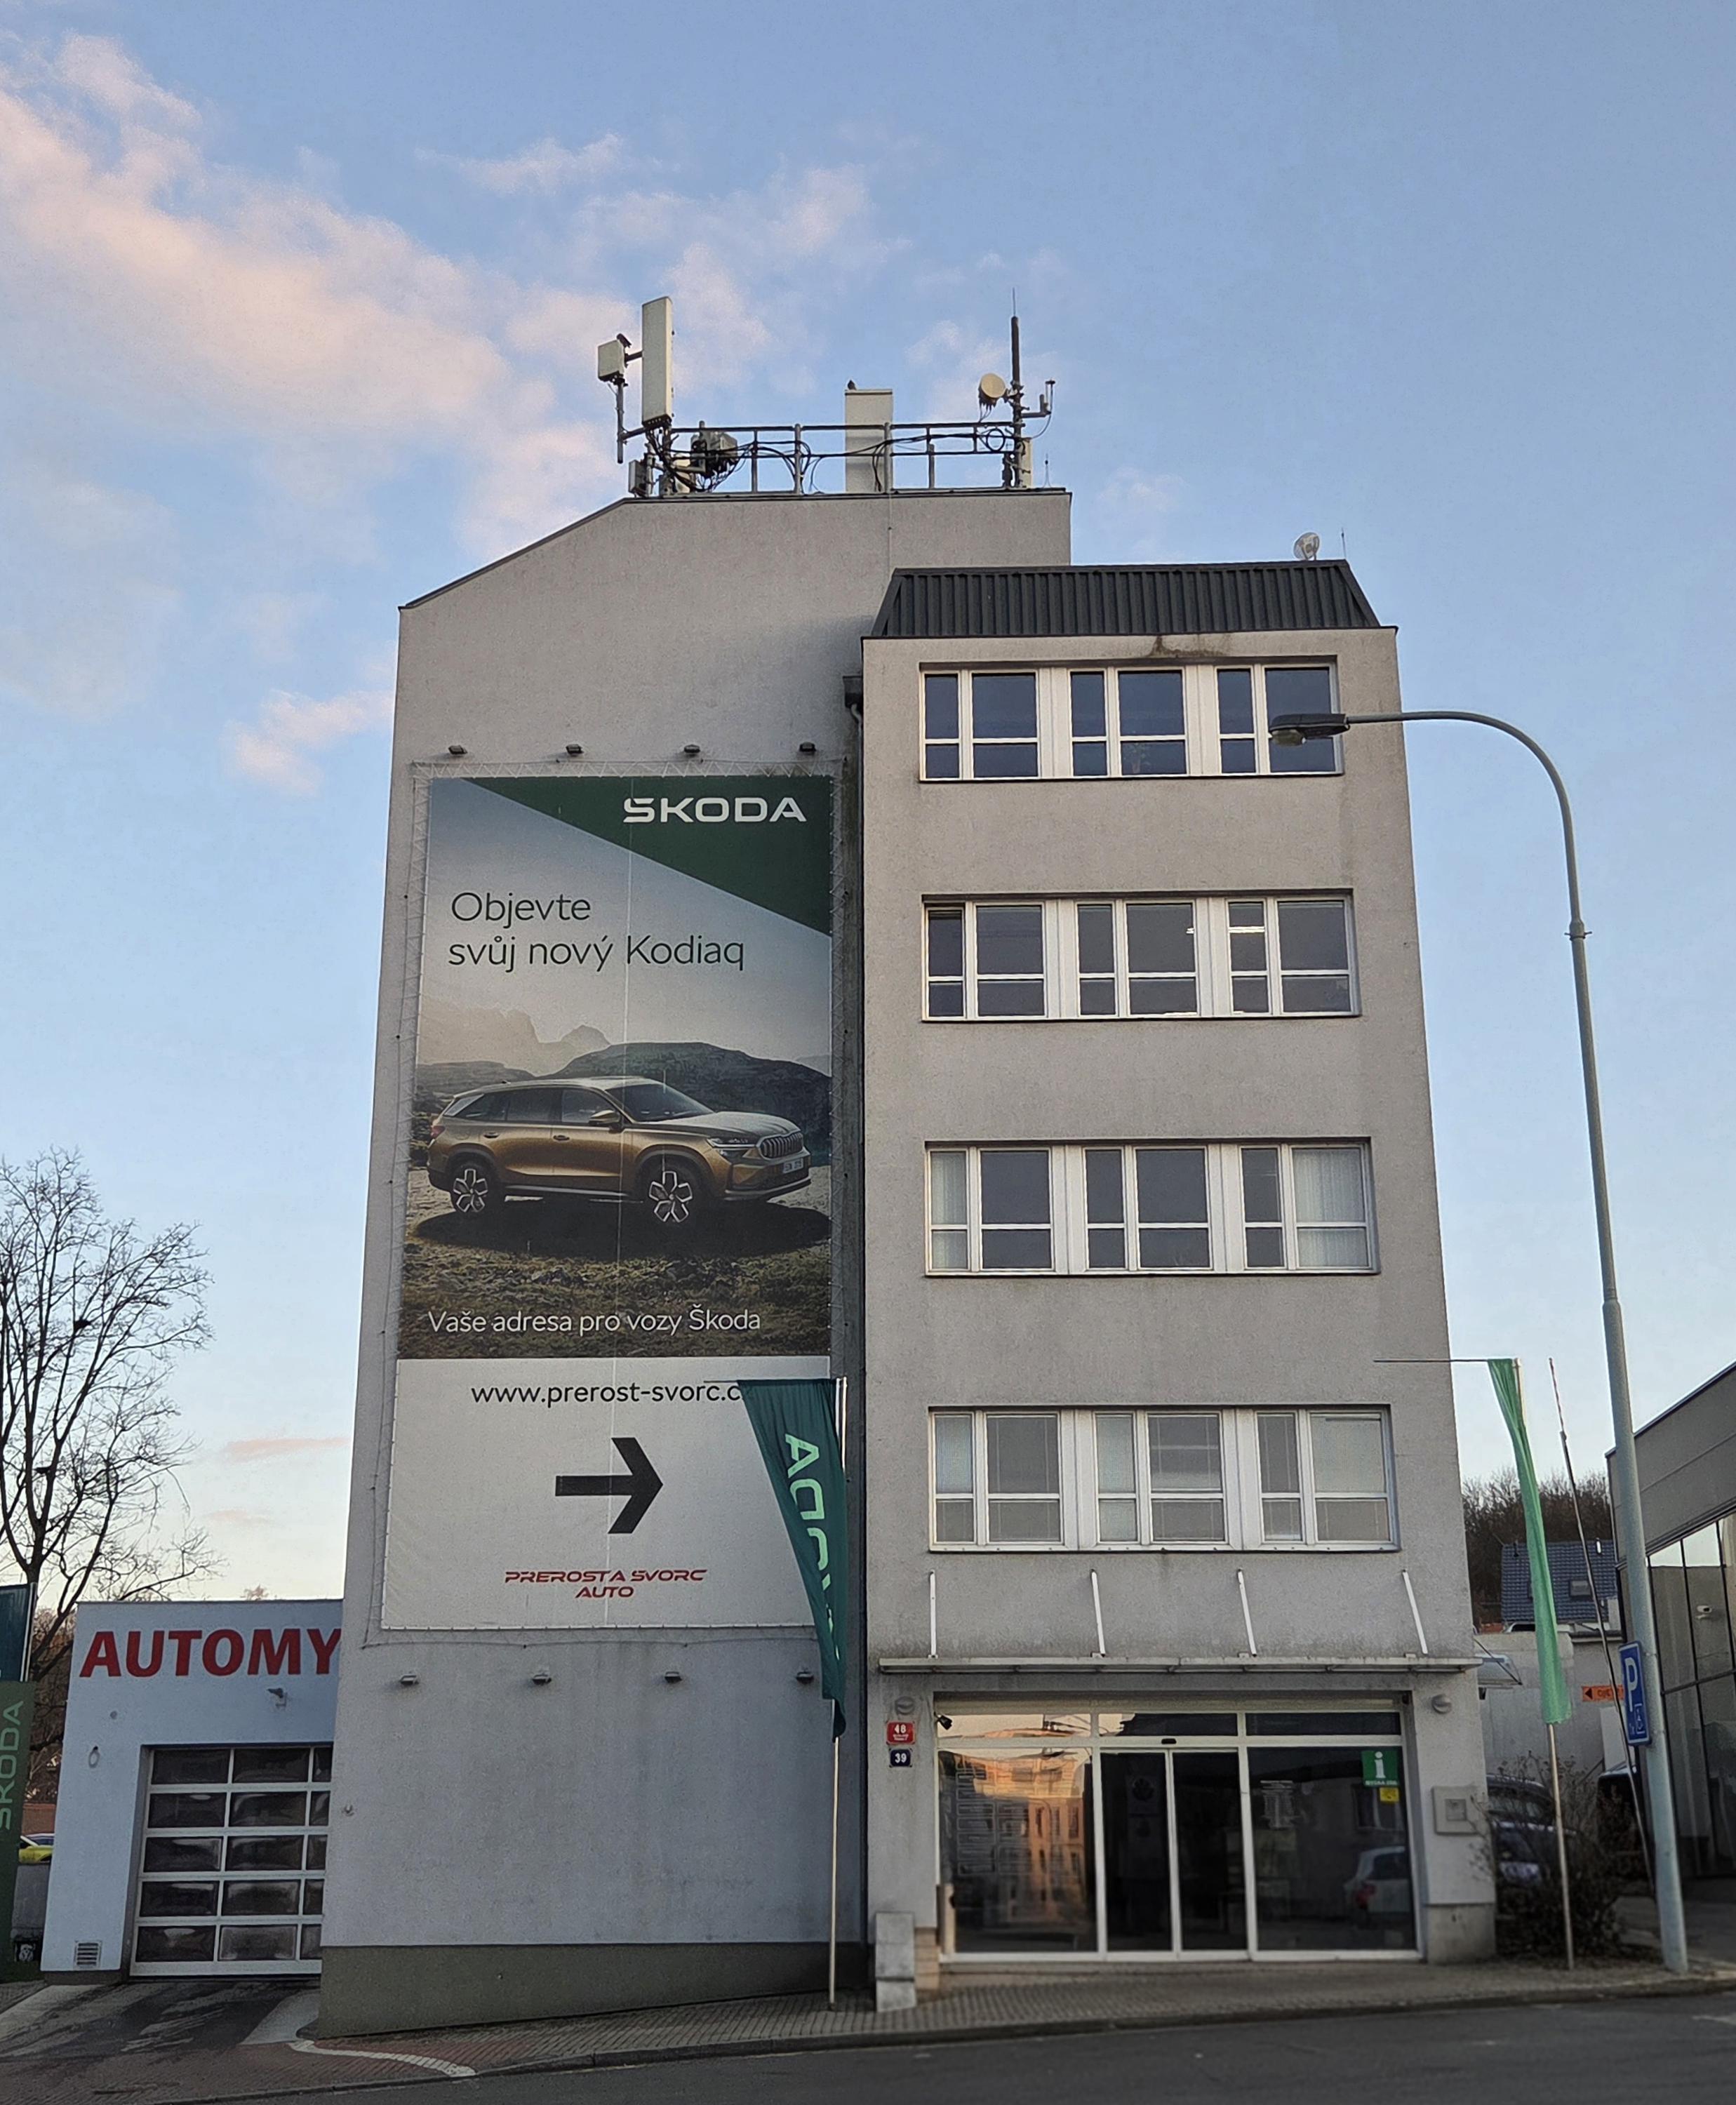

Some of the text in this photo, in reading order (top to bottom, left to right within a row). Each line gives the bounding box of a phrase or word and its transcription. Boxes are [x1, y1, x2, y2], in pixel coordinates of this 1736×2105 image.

[451, 892, 591, 928] Objevte
[448, 935, 744, 973] svůj nový Kodiaq
[428, 1304, 760, 1337] Vaše adresa pro vozy Škoda
[471, 1382, 741, 1408] www.prerost-svorc.c
[505, 1569, 707, 1583] PREROSTA SVORC
[575, 1586, 634, 1598] AUTO
[1624, 1657, 1638, 1713] P
[895, 1752, 907, 1763] 39
